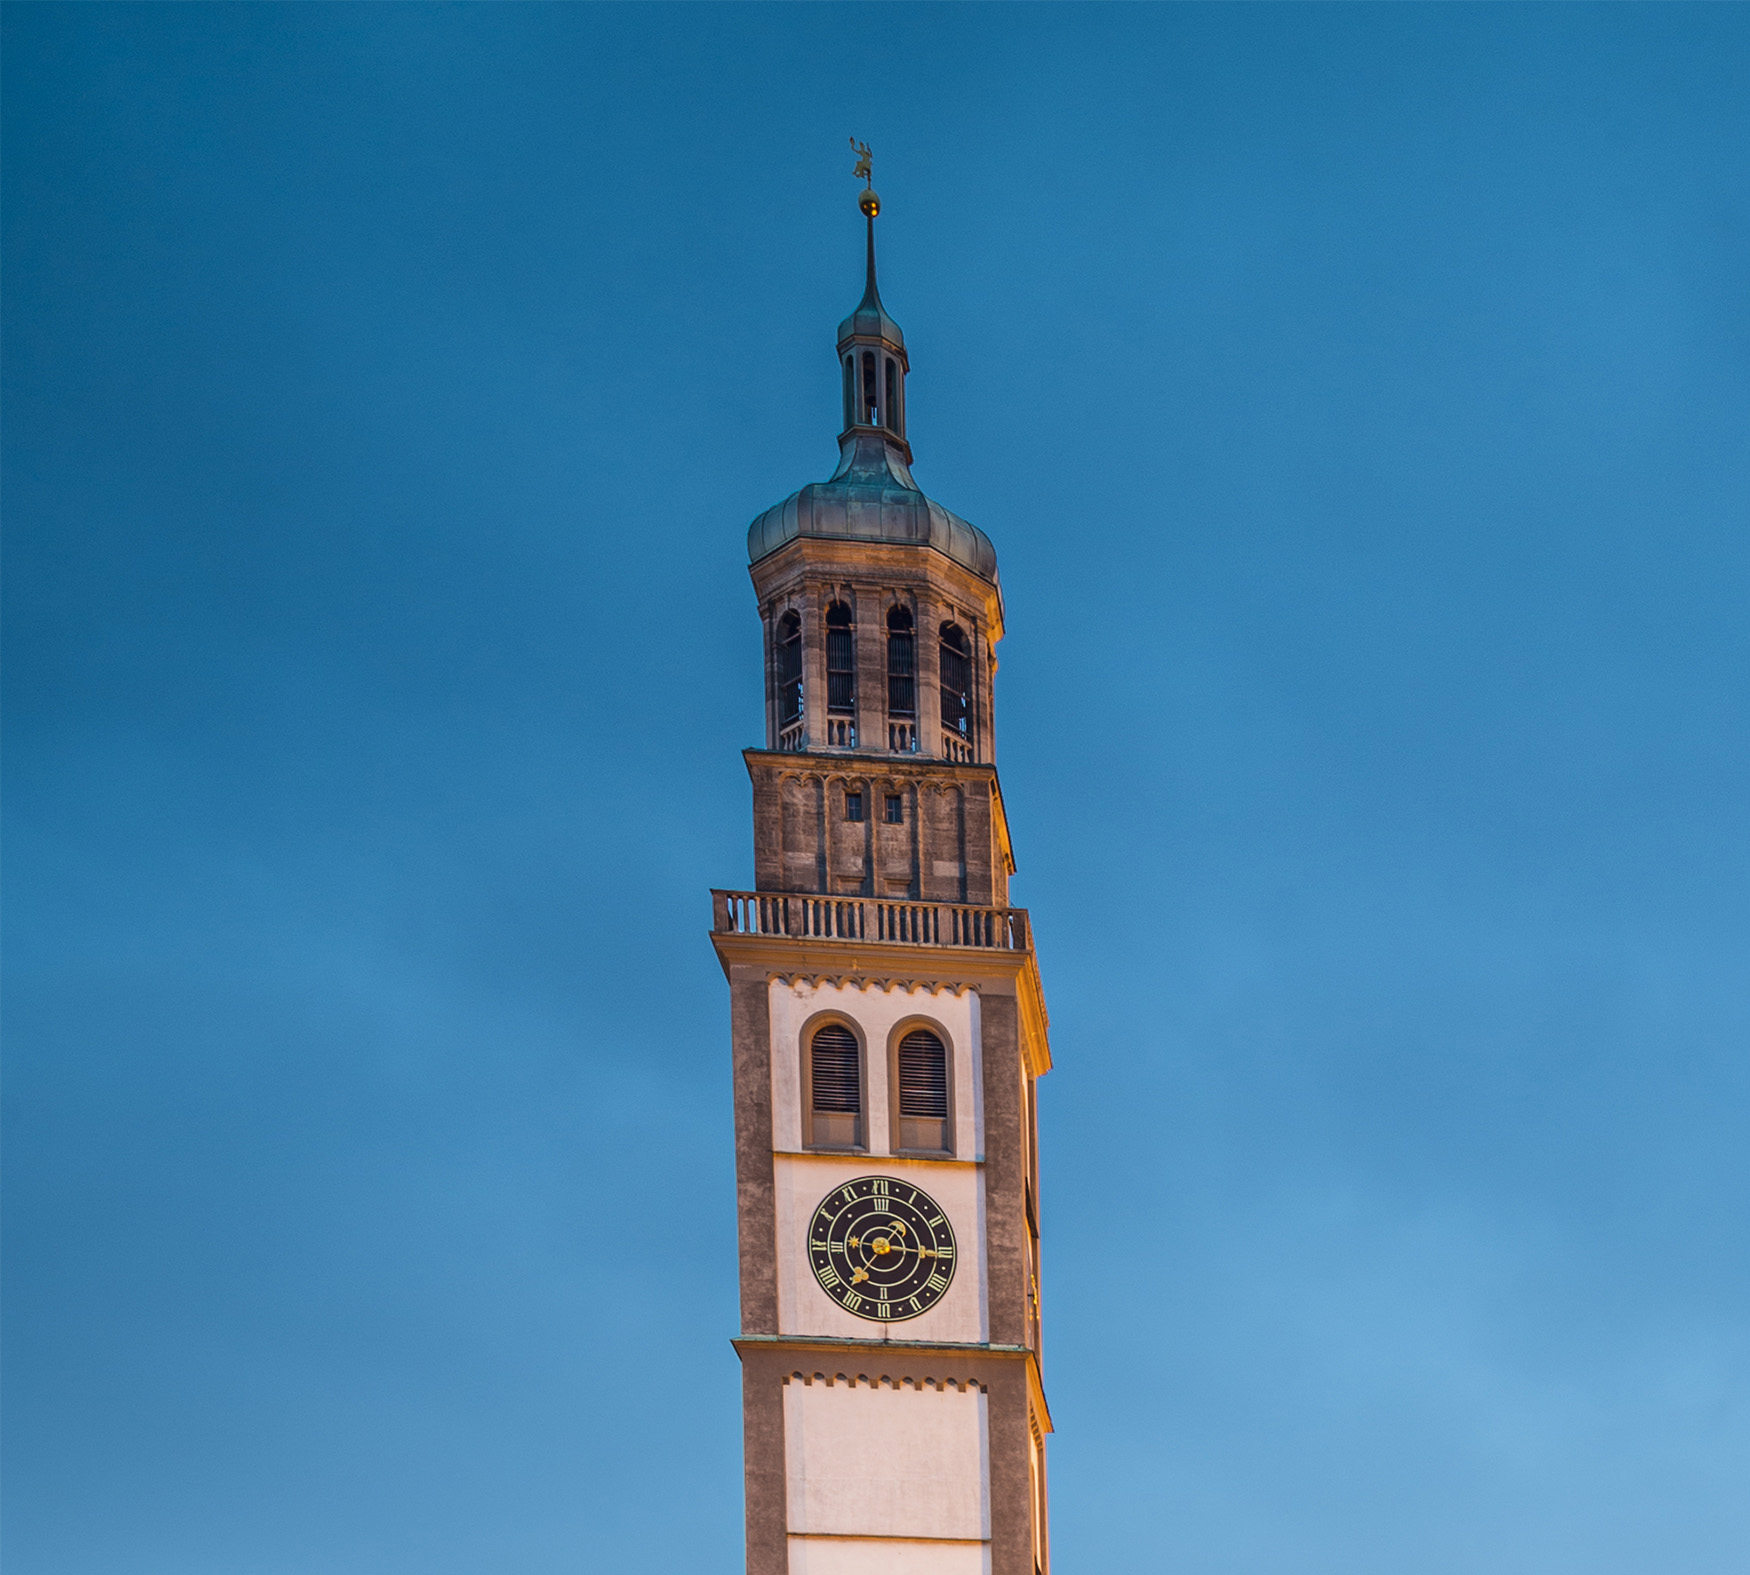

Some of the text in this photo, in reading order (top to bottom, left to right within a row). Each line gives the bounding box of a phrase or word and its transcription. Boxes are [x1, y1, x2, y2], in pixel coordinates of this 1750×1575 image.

[842, 1186, 857, 1202] XI
[872, 1180, 888, 1195] XII
[909, 1191, 917, 1204] I
[874, 1199, 889, 1211] IIII
[820, 1208, 834, 1221] X
[929, 1215, 944, 1228] II
[812, 1238, 827, 1250] IX
[938, 1247, 952, 1258] III
